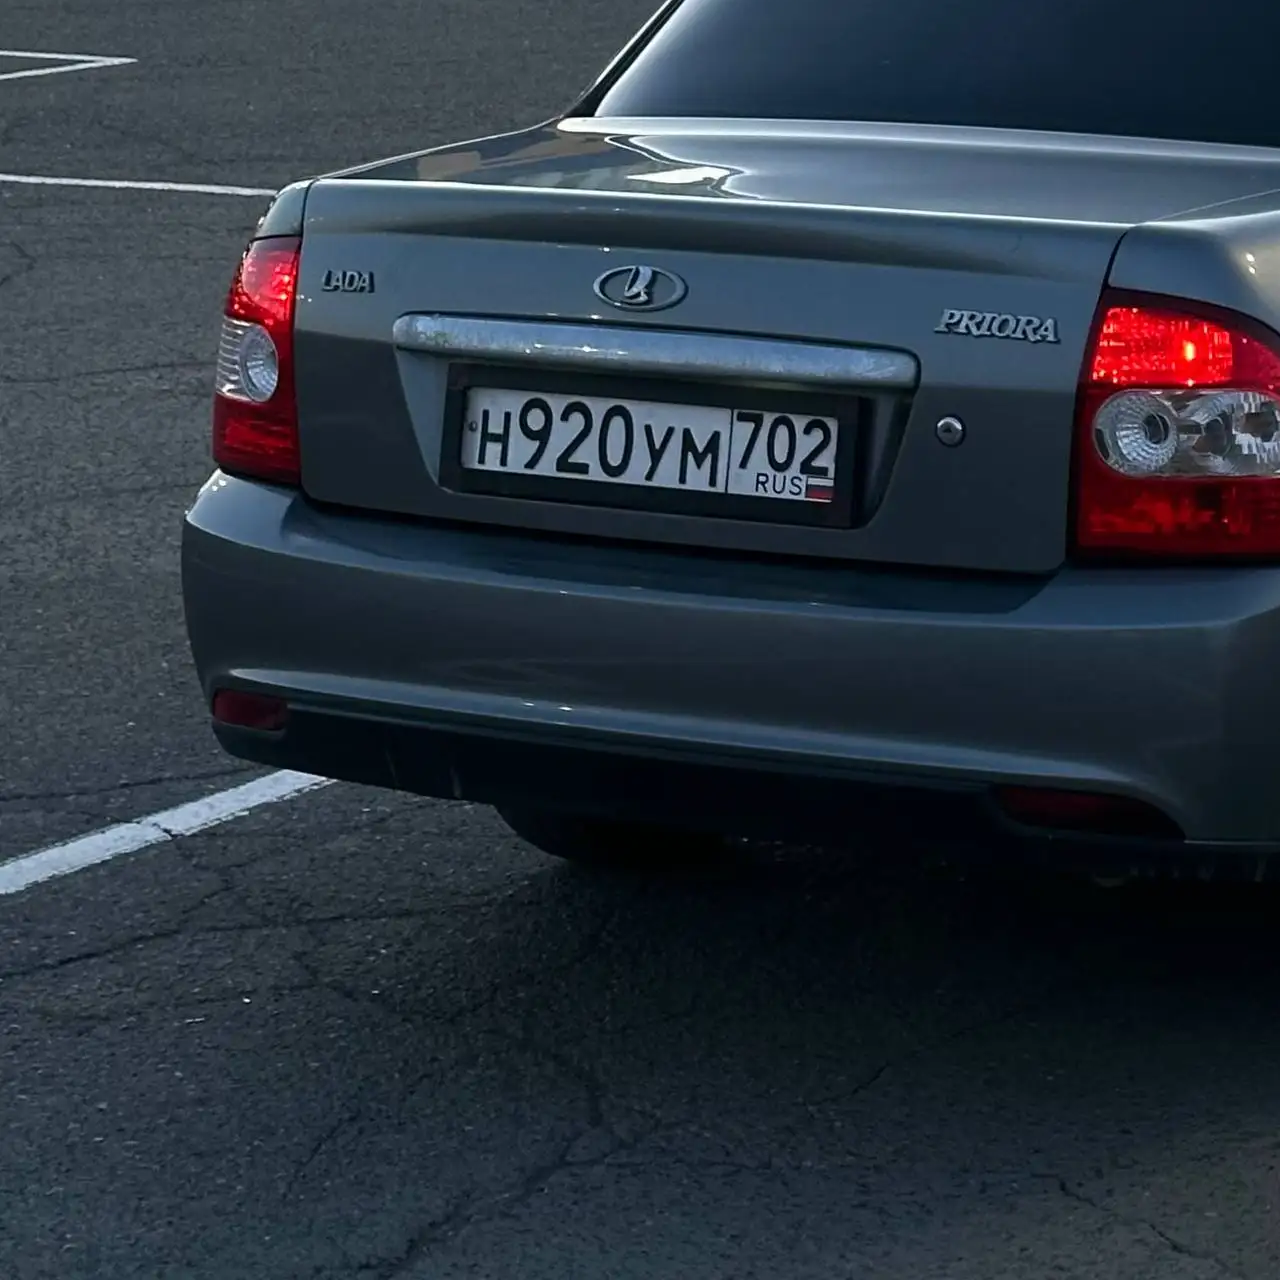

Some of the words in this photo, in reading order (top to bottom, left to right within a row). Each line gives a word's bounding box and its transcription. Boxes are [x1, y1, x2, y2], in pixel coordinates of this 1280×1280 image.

[321, 269, 375, 293] LADA
[933, 308, 1061, 344] PRIORA
[736, 411, 833, 476] 702
[754, 473, 802, 496] RUS
